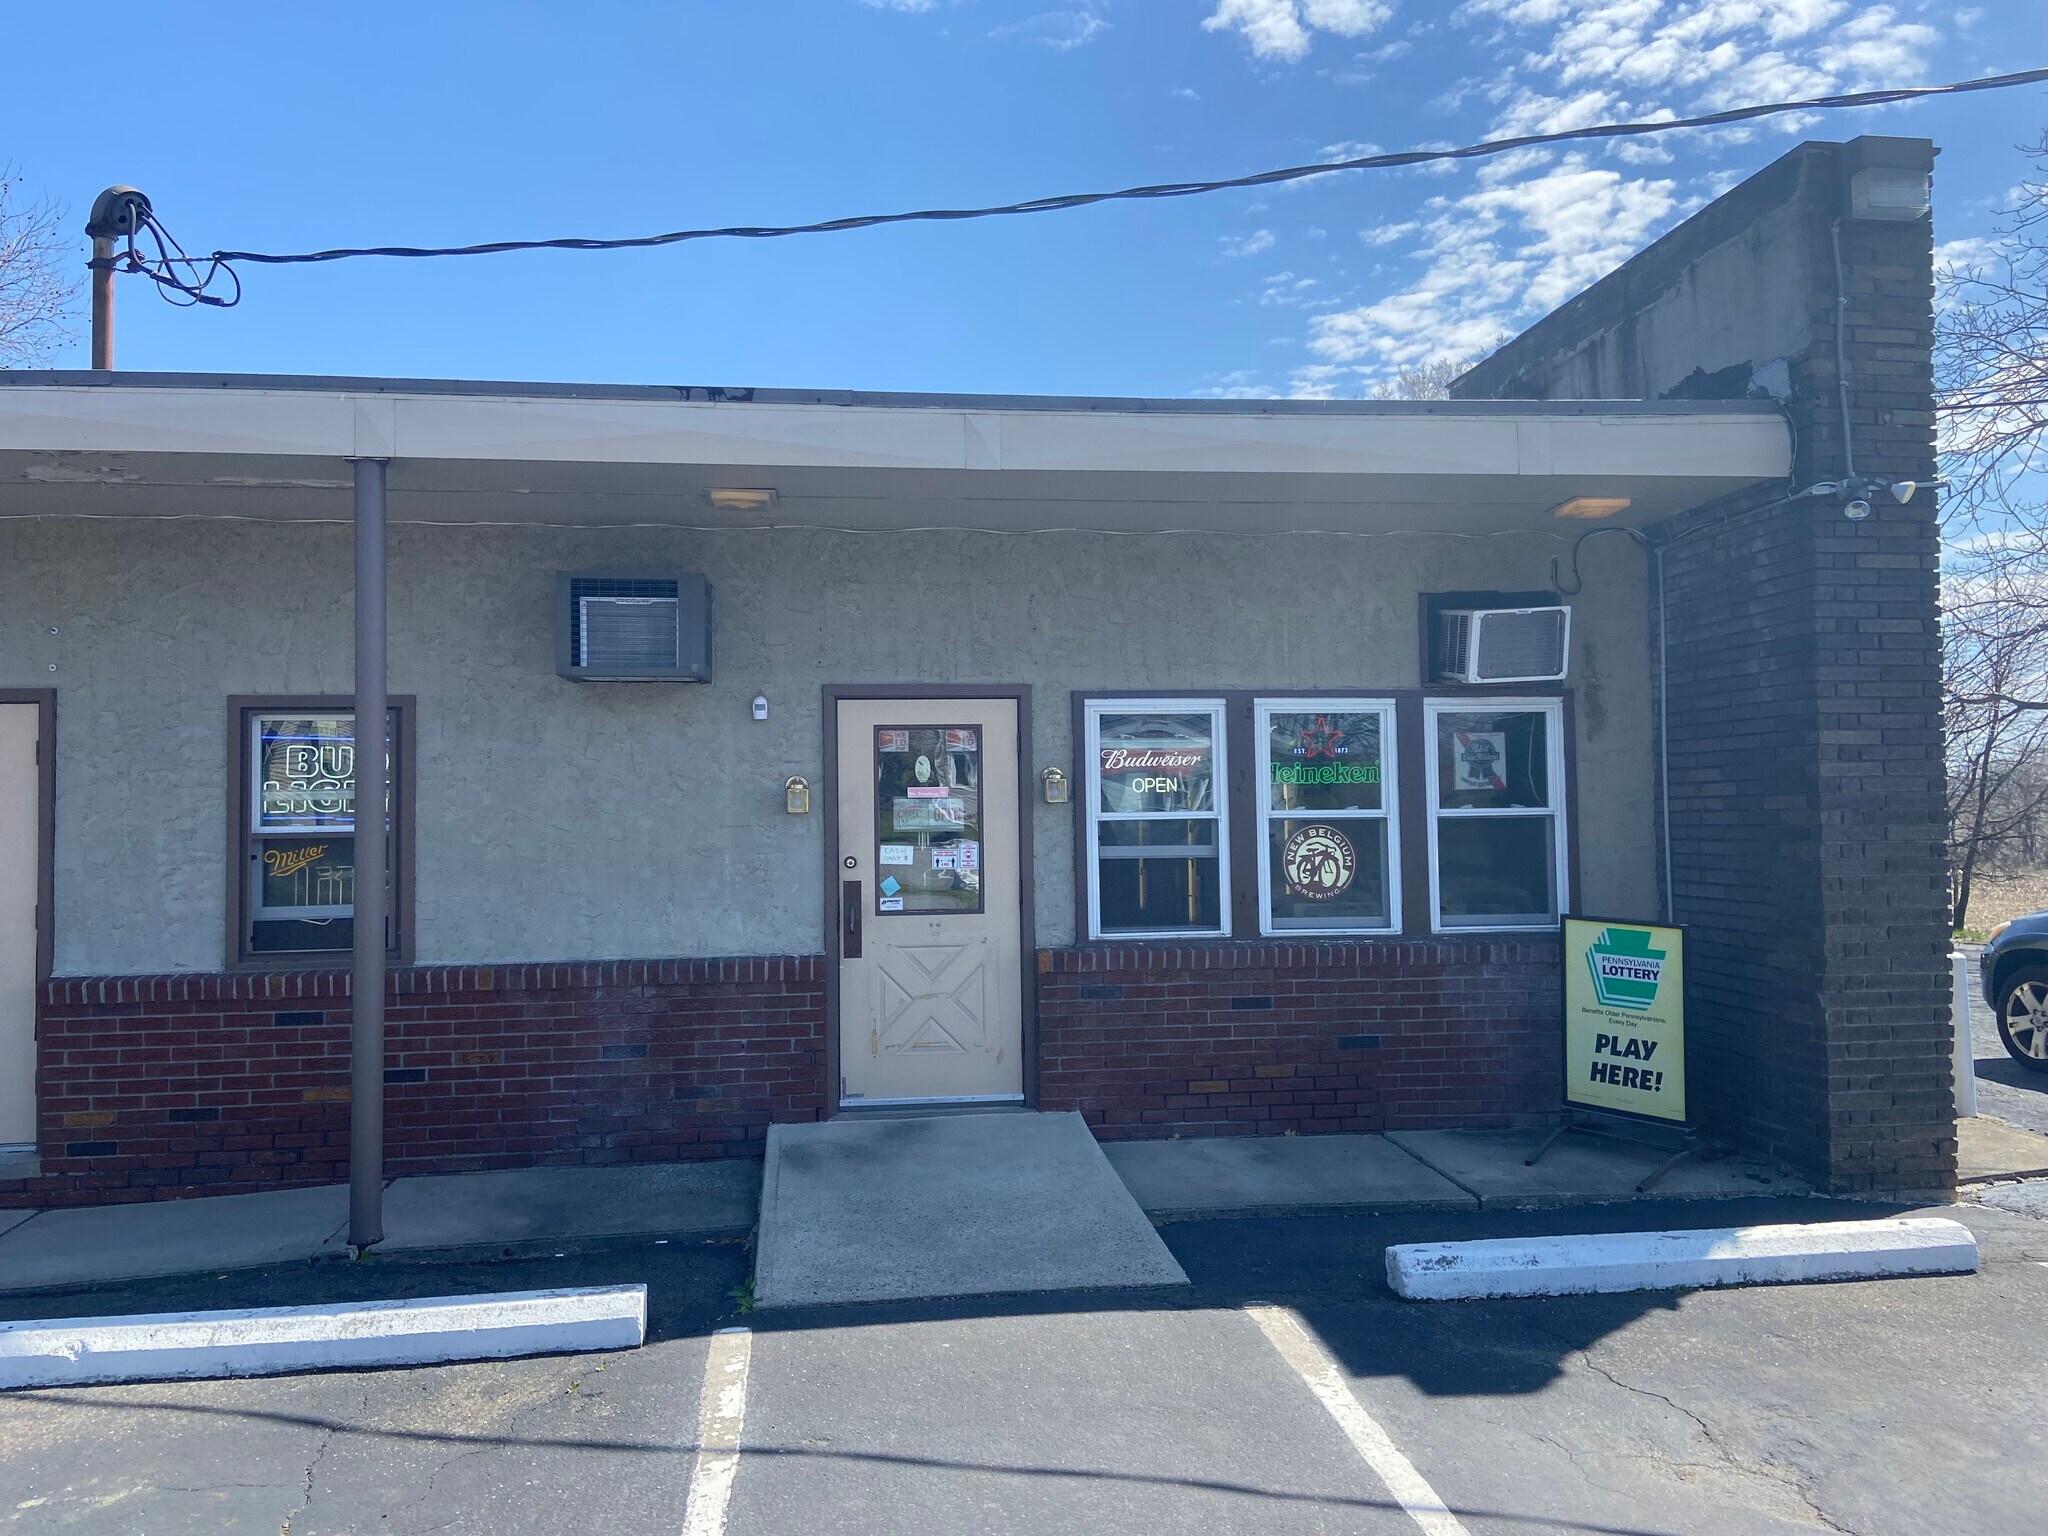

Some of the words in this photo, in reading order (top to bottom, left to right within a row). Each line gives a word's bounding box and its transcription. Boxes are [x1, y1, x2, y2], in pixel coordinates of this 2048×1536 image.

[1471, 743, 1490, 752] Pabst
[286, 745, 389, 778] BU
[1101, 749, 1202, 769] Budweiser
[1270, 761, 1380, 784] Heineken
[1132, 777, 1178, 793] OPEN
[1287, 834, 1305, 860] NEW
[1308, 828, 1352, 866] BELGIUM
[264, 845, 328, 871] Miller
[1295, 885, 1340, 899] BREWING
[1602, 956, 1660, 969] PENNSYLVANIA
[1602, 964, 1660, 981] LOTTERY
[1581, 1007, 1604, 1016] Benefits
[1605, 1009, 1620, 1017] Older
[1608, 1018, 1625, 1026] Every
[1595, 1033, 1658, 1061] PLAY
[1590, 1061, 1663, 1092] HERE!
